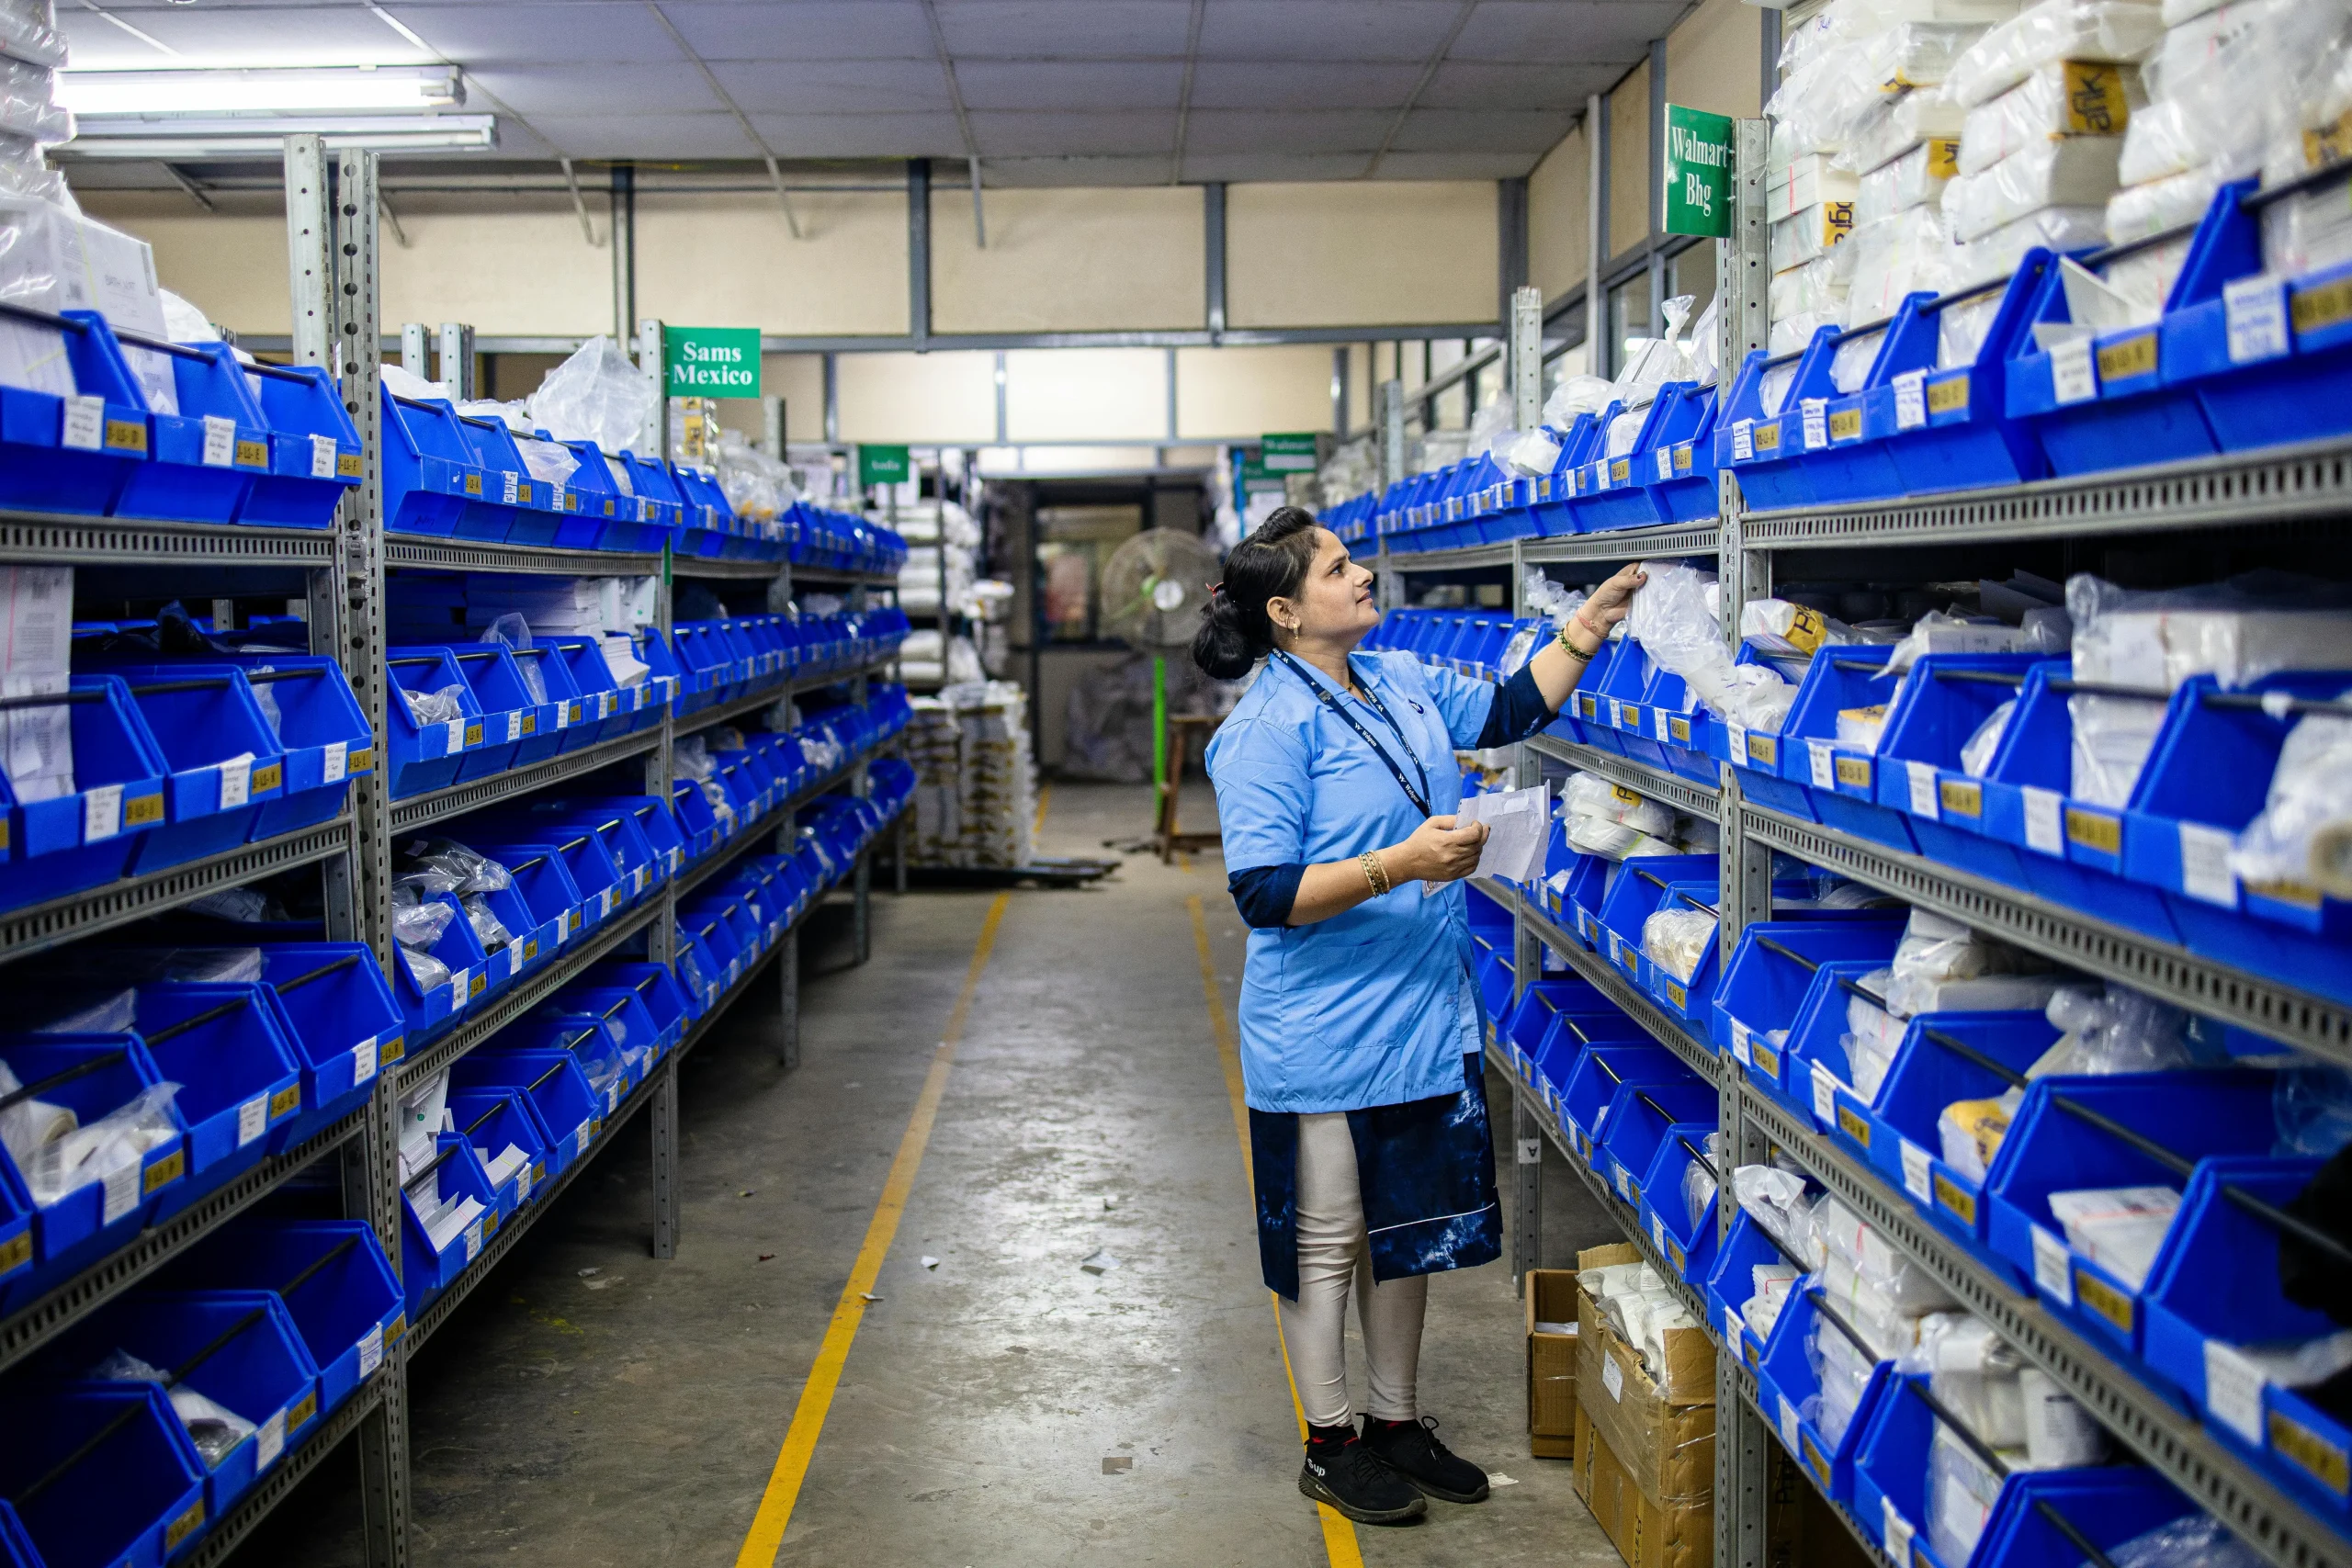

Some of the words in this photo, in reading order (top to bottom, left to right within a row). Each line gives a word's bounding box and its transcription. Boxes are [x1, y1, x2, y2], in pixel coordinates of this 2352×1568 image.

[1671, 126, 1728, 169] Walmart
[1685, 172, 1712, 217] Bhg
[683, 341, 742, 362] Sams
[673, 364, 752, 386] Mexico
[1307, 1458, 1326, 1477] Sup
